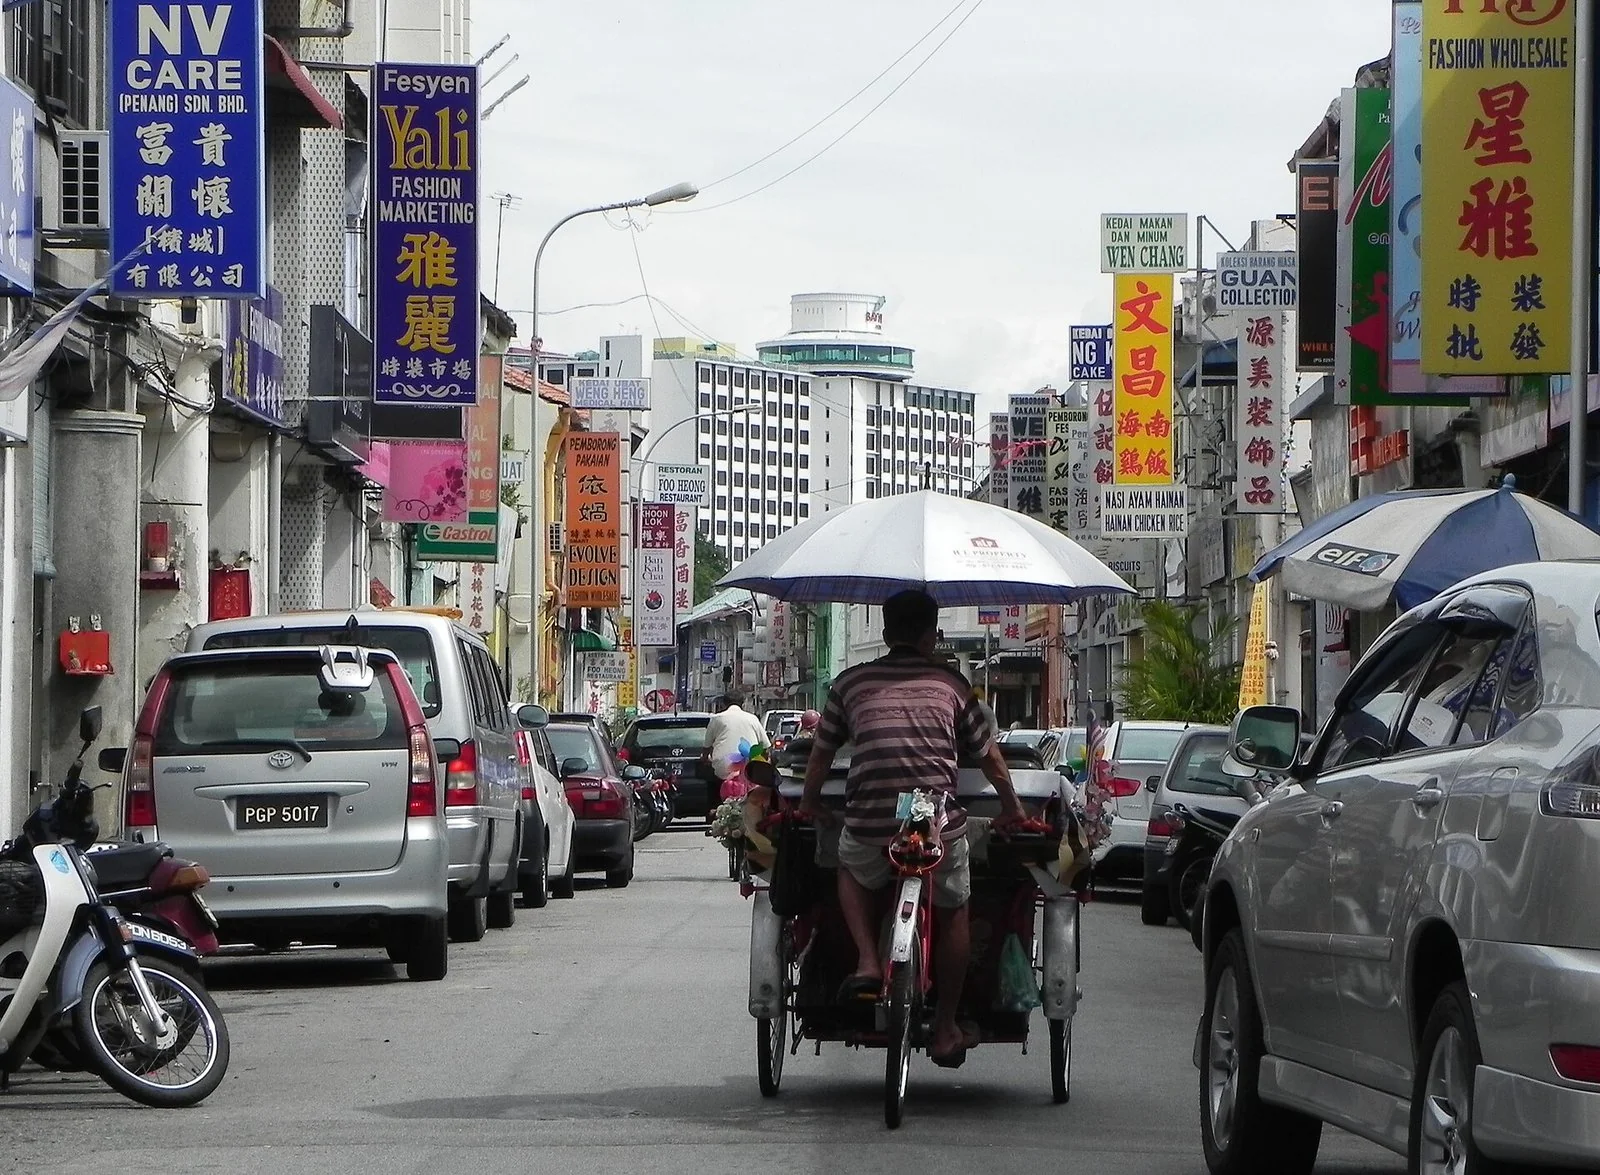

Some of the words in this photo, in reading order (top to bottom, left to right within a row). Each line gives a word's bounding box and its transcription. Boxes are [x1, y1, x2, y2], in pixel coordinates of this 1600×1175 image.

[138, 5, 232, 55] NV
[1429, 38, 1485, 69] FASHION
[1490, 37, 1568, 68] WHOLESALE
[127, 59, 242, 90] CARE
[384, 69, 470, 99] Fesyen
[119, 93, 179, 114] (PENANG)
[184, 94, 213, 114] SDN.
[218, 94, 248, 114] BHD.
[135, 121, 233, 167] 富貴
[380, 104, 472, 171] Yali
[135, 174, 234, 219] 關懷
[392, 176, 461, 199] FASHION
[380, 200, 474, 224] MARKETING
[1106, 217, 1133, 229] KEDAI
[1139, 217, 1173, 229] MAKAN
[1111, 231, 1130, 243] DAN
[1137, 231, 1168, 243] MINUM
[1106, 245, 1136, 268] WEN
[1140, 245, 1184, 268] CHANG
[126, 263, 244, 288] 有限公司
[395, 231, 458, 354] 雅麗
[1072, 327, 1102, 339] KEDAI
[1120, 280, 1169, 399] 文昌
[1072, 341, 1097, 365] NG
[1072, 366, 1106, 378] CAKE
[575, 387, 609, 400] WENG
[613, 387, 645, 400] HENG
[569, 437, 617, 451] PEMBORONG
[575, 454, 611, 467] PAKAIAN
[658, 466, 703, 474] RESTORAN
[658, 478, 675, 492] FOO
[677, 479, 706, 493] HEONG
[659, 493, 703, 503] RESTAURANT
[1105, 491, 1125, 509] NASI
[1128, 491, 1153, 509] AYAM
[1155, 491, 1184, 509] HAINAN
[644, 518, 663, 526] LOK
[1105, 514, 1132, 532] HAINAN
[1134, 514, 1166, 532] CHICKEN
[1168, 514, 1184, 532] RICE
[442, 525, 494, 541] Castrol
[569, 545, 617, 563] EVOLVE
[1317, 548, 1369, 566] elf
[1108, 561, 1141, 571] BISCUITS
[569, 568, 617, 586] DESIGN
[245, 806, 277, 824] PGP
[281, 806, 320, 823] 5017
